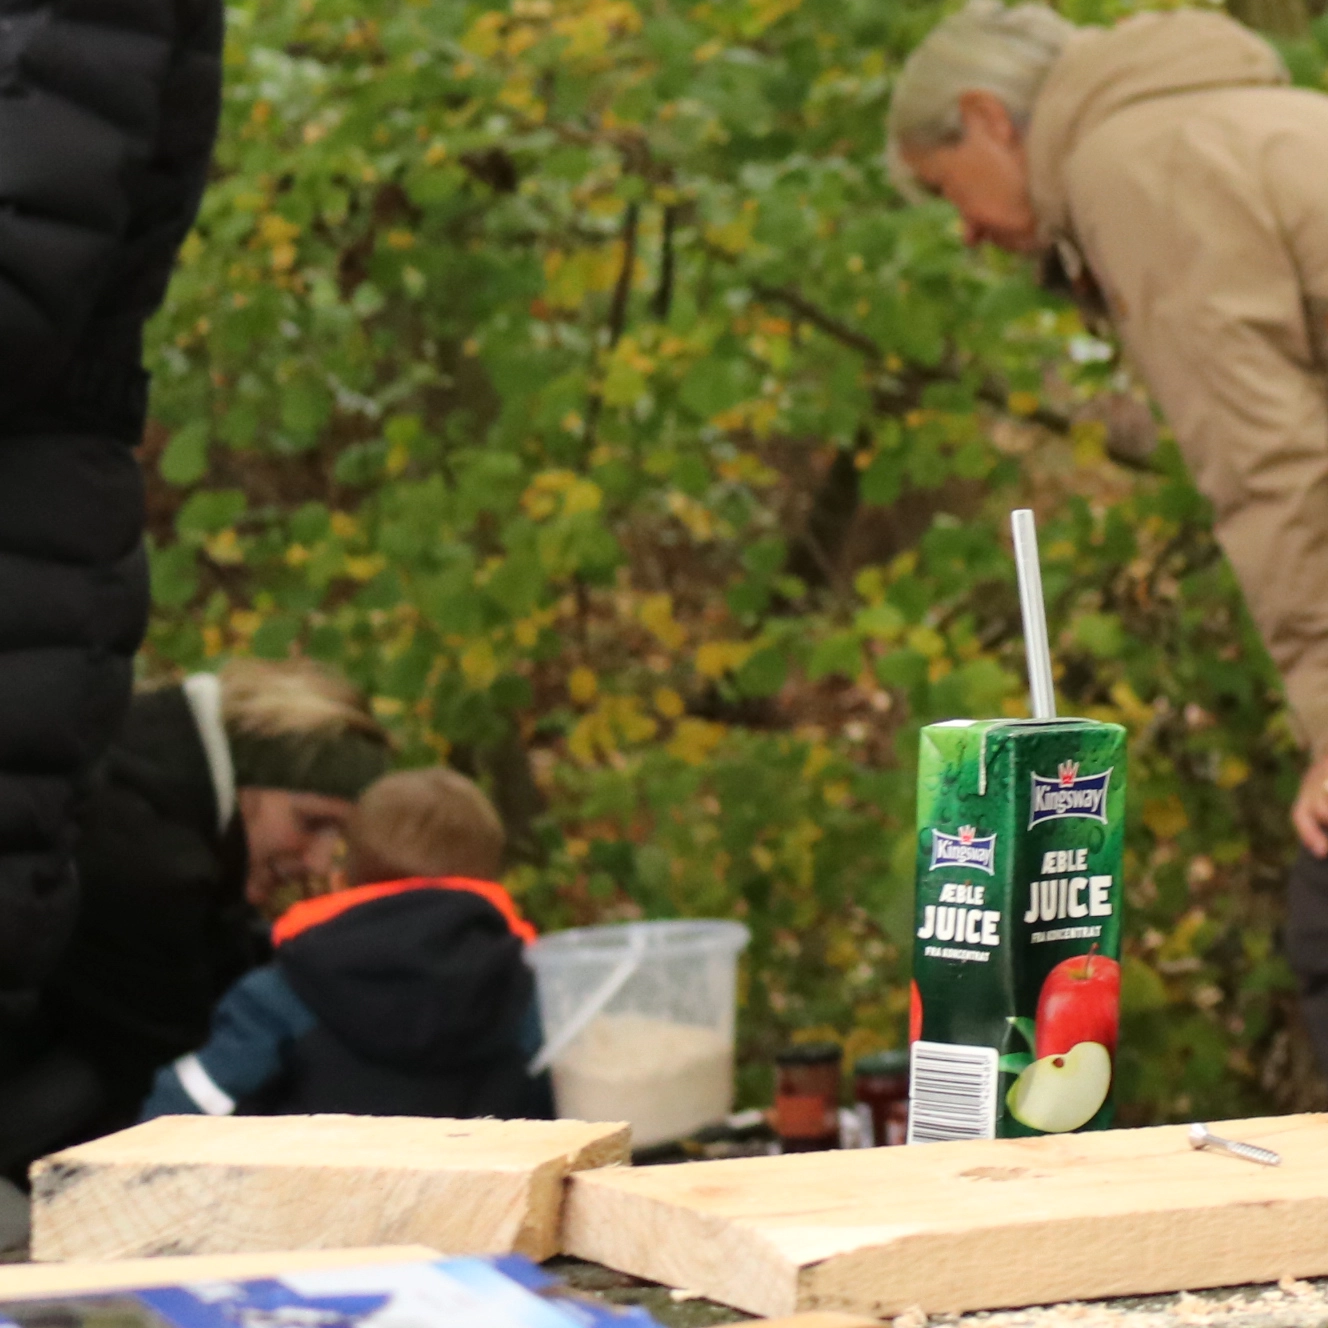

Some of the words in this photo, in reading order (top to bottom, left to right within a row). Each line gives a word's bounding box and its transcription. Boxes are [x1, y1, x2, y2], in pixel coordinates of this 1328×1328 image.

[1034, 785, 1103, 813] Kingsway
[937, 840, 991, 865] Kingsway
[1041, 849, 1088, 874] ÆBLE
[939, 883, 985, 906] ÆBLE
[1024, 875, 1112, 923] JUICE
[917, 905, 1001, 945] JUICE
